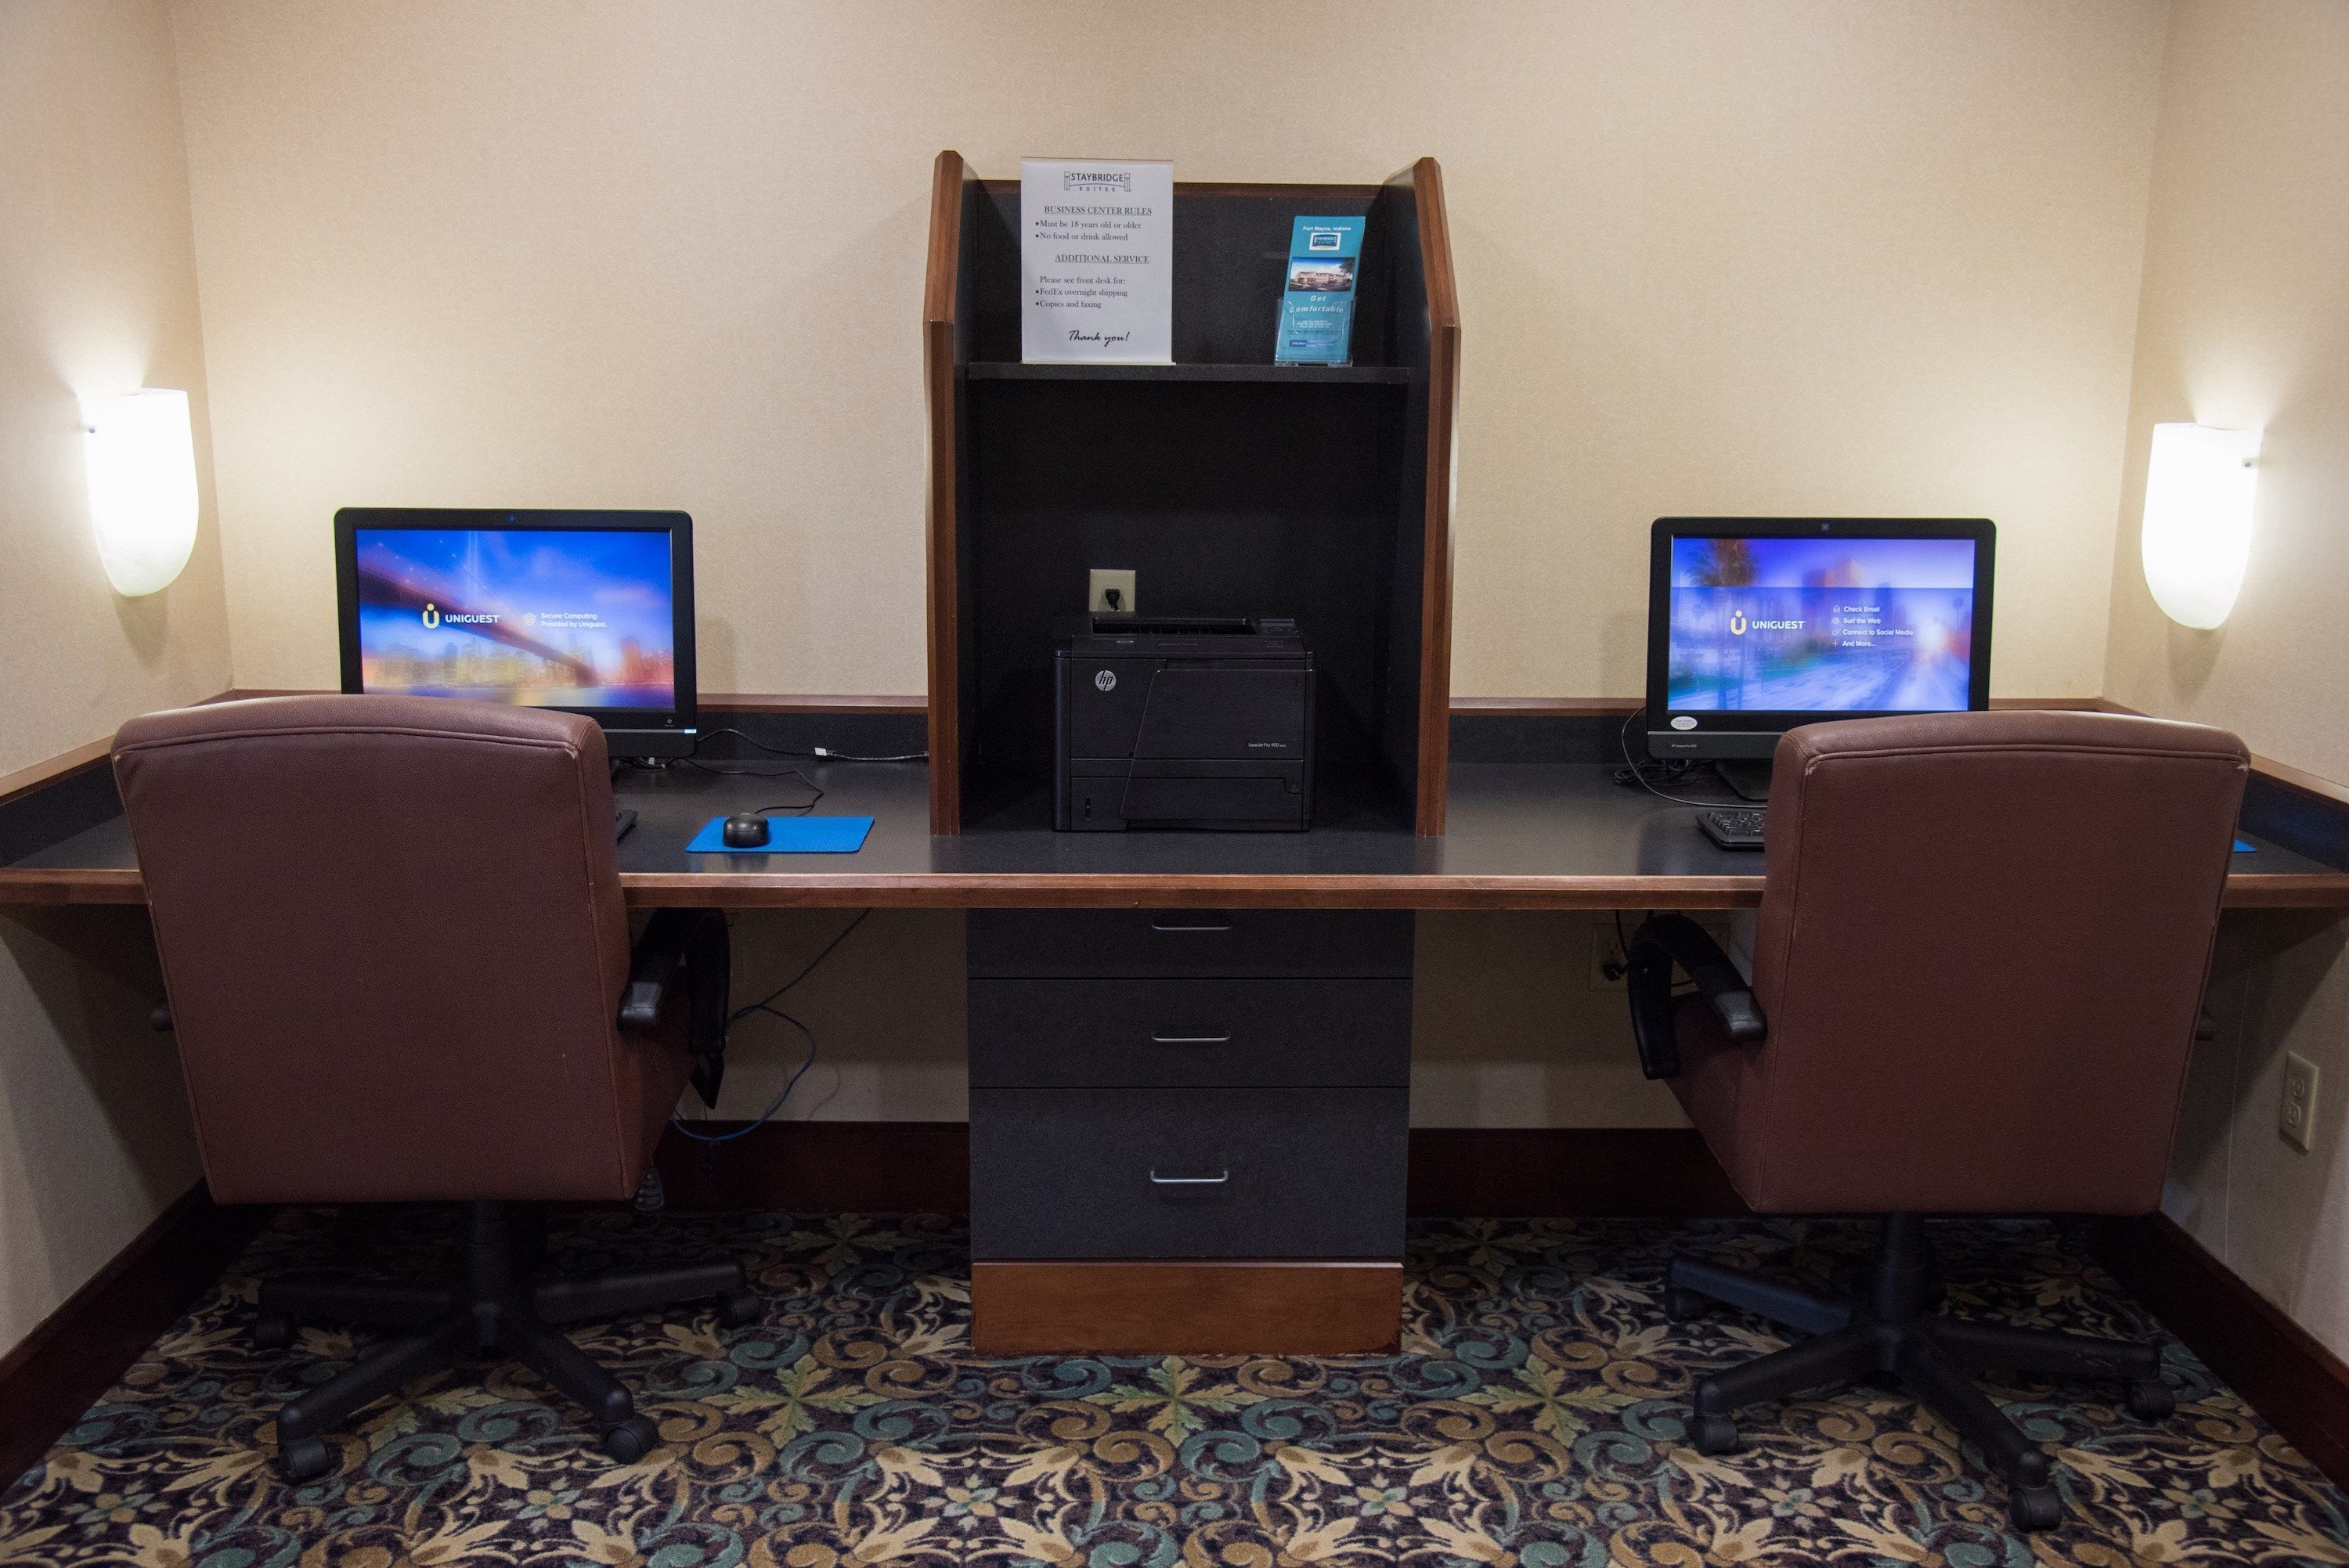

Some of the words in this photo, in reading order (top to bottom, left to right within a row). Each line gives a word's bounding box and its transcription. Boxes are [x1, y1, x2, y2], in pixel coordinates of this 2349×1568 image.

[1070, 173, 1124, 182] STAYBRIDGE
[1044, 206, 1086, 214] BUSINESS
[1055, 254, 1112, 263] ADDITIONAL
[1064, 289, 1097, 297] overnight
[1099, 289, 1128, 297] shipping
[1040, 301, 1064, 309] Copies
[1081, 301, 1102, 309] faxing
[1068, 330, 1101, 342] Thank
[1104, 331, 1130, 348] you!
[445, 614, 500, 624] UNIGUEST
[564, 612, 597, 621] Computing
[569, 621, 578, 629] by
[578, 621, 608, 629] Uniguest.
[1752, 620, 1805, 629] UNIGUEST
[1098, 670, 1113, 691] hp
